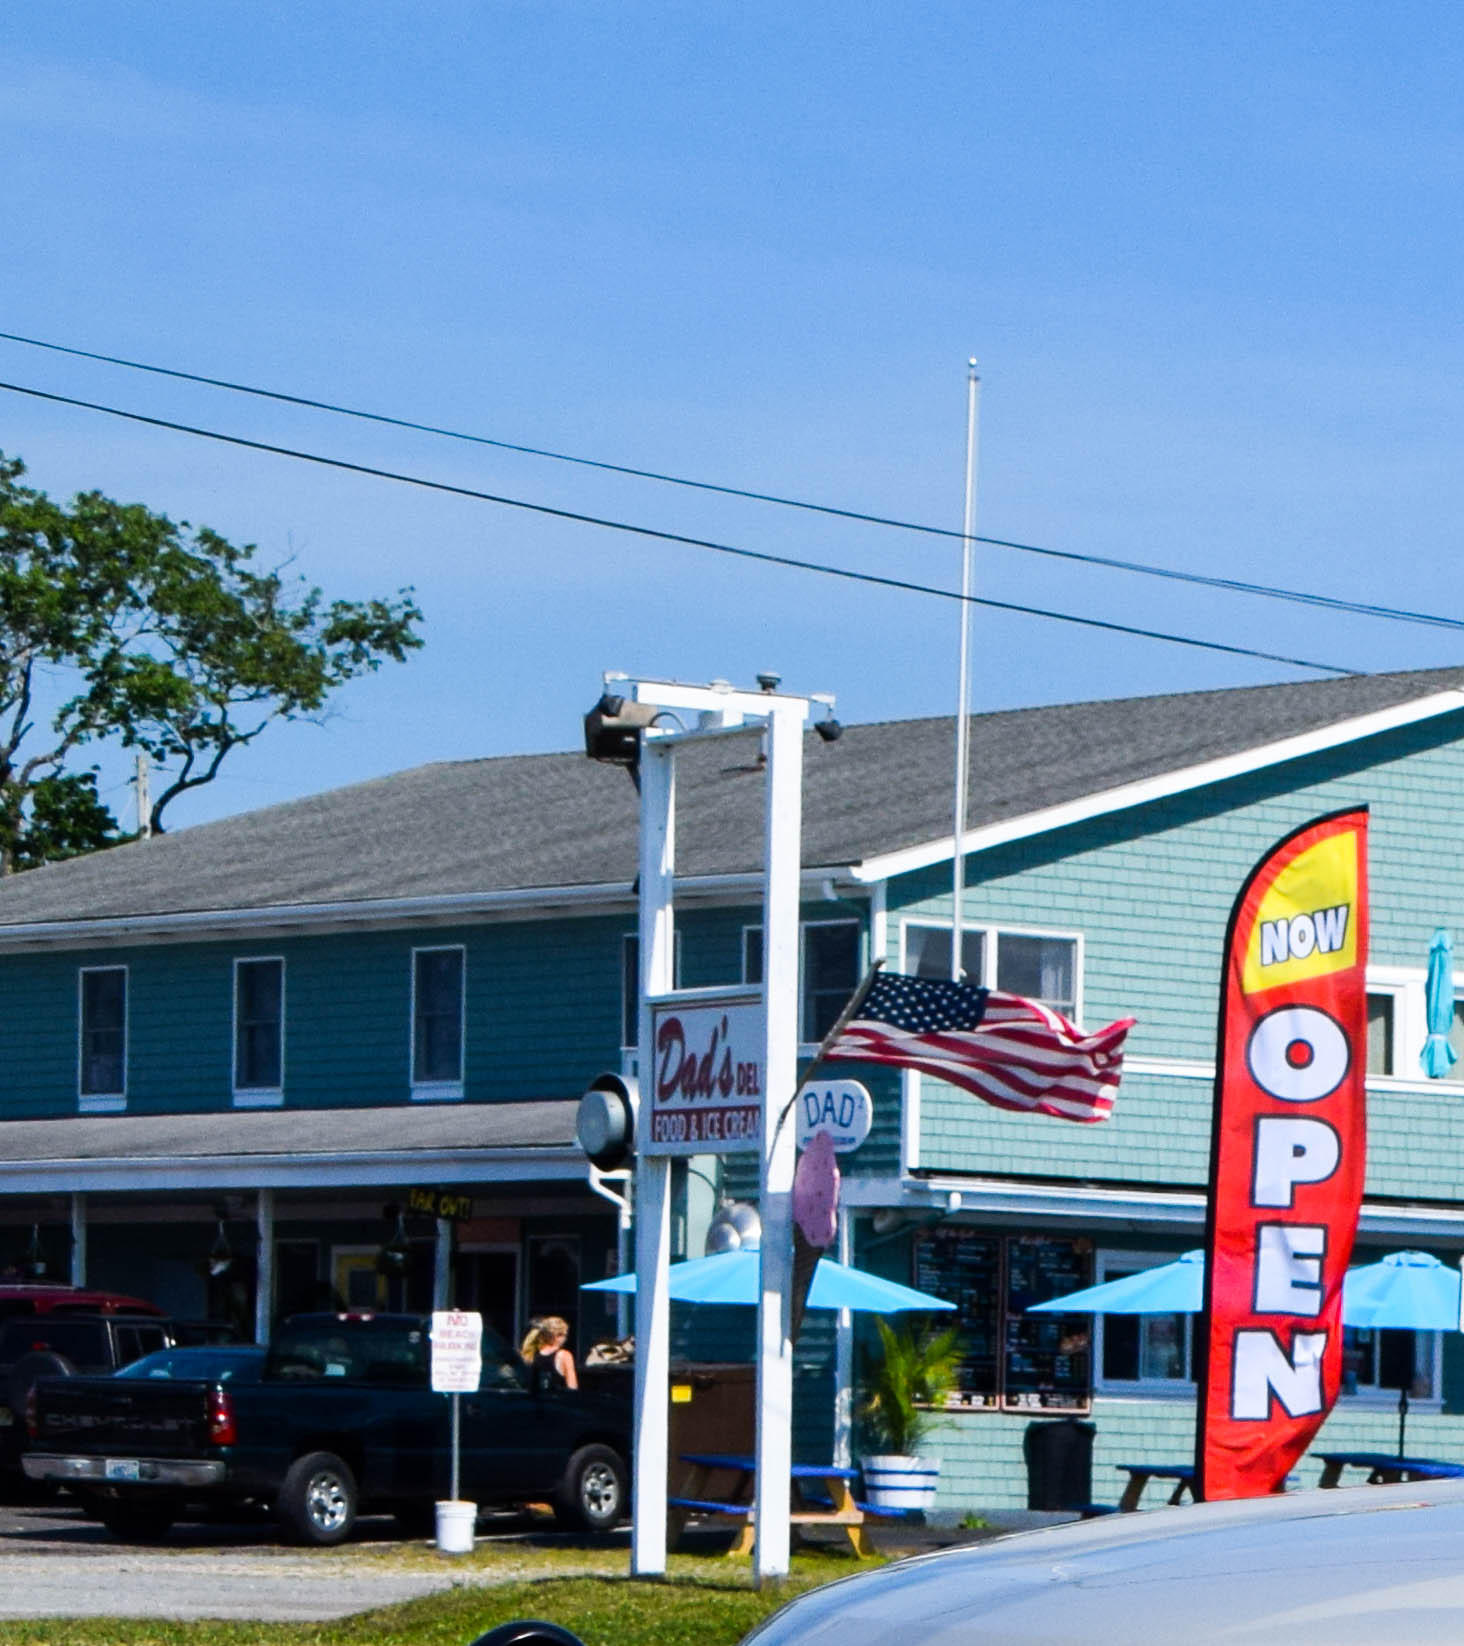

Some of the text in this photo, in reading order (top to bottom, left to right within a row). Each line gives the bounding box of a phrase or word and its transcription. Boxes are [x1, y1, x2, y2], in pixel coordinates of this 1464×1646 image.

[1260, 903, 1351, 967] NOW
[657, 1013, 760, 1103] Dad's DEL
[655, 1113, 687, 1142] FOOD
[690, 1113, 699, 1140] &
[702, 1111, 721, 1139] ICE
[1230, 1003, 1352, 1421] OPEN
